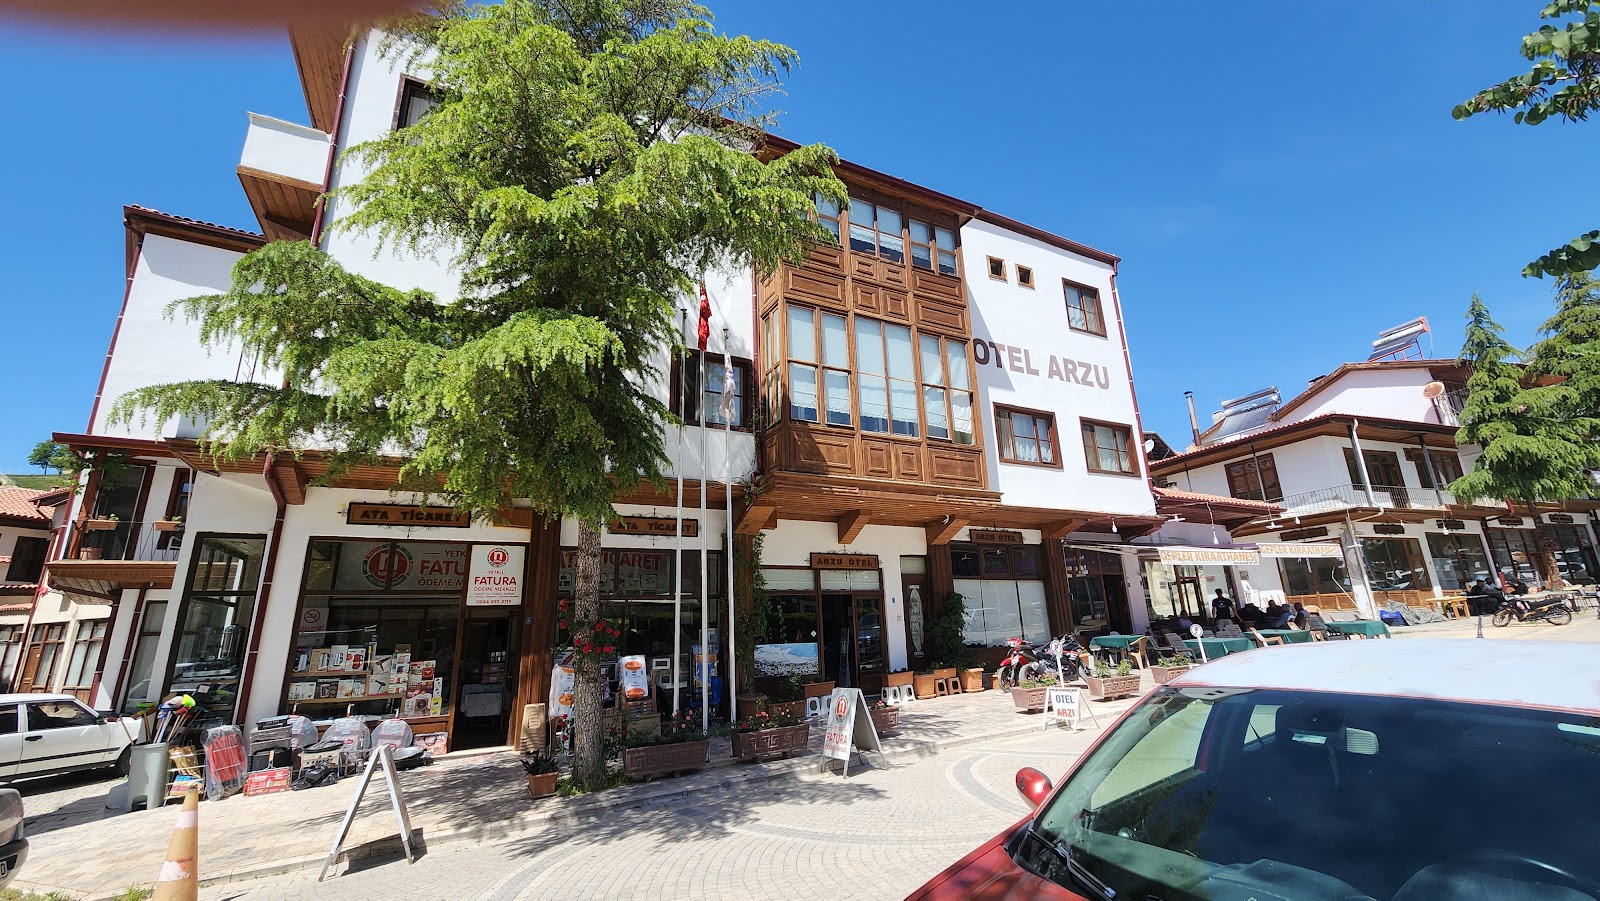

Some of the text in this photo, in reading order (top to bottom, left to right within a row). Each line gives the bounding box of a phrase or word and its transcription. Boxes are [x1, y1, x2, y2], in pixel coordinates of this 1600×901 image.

[972, 338, 1110, 390] OTEL ARZU
[360, 510, 389, 520] ATA
[849, 559, 873, 567] OTEL
[418, 577, 453, 586] ÖDEME
[474, 576, 517, 586] FATURA
[1055, 694, 1075, 704] OTEL
